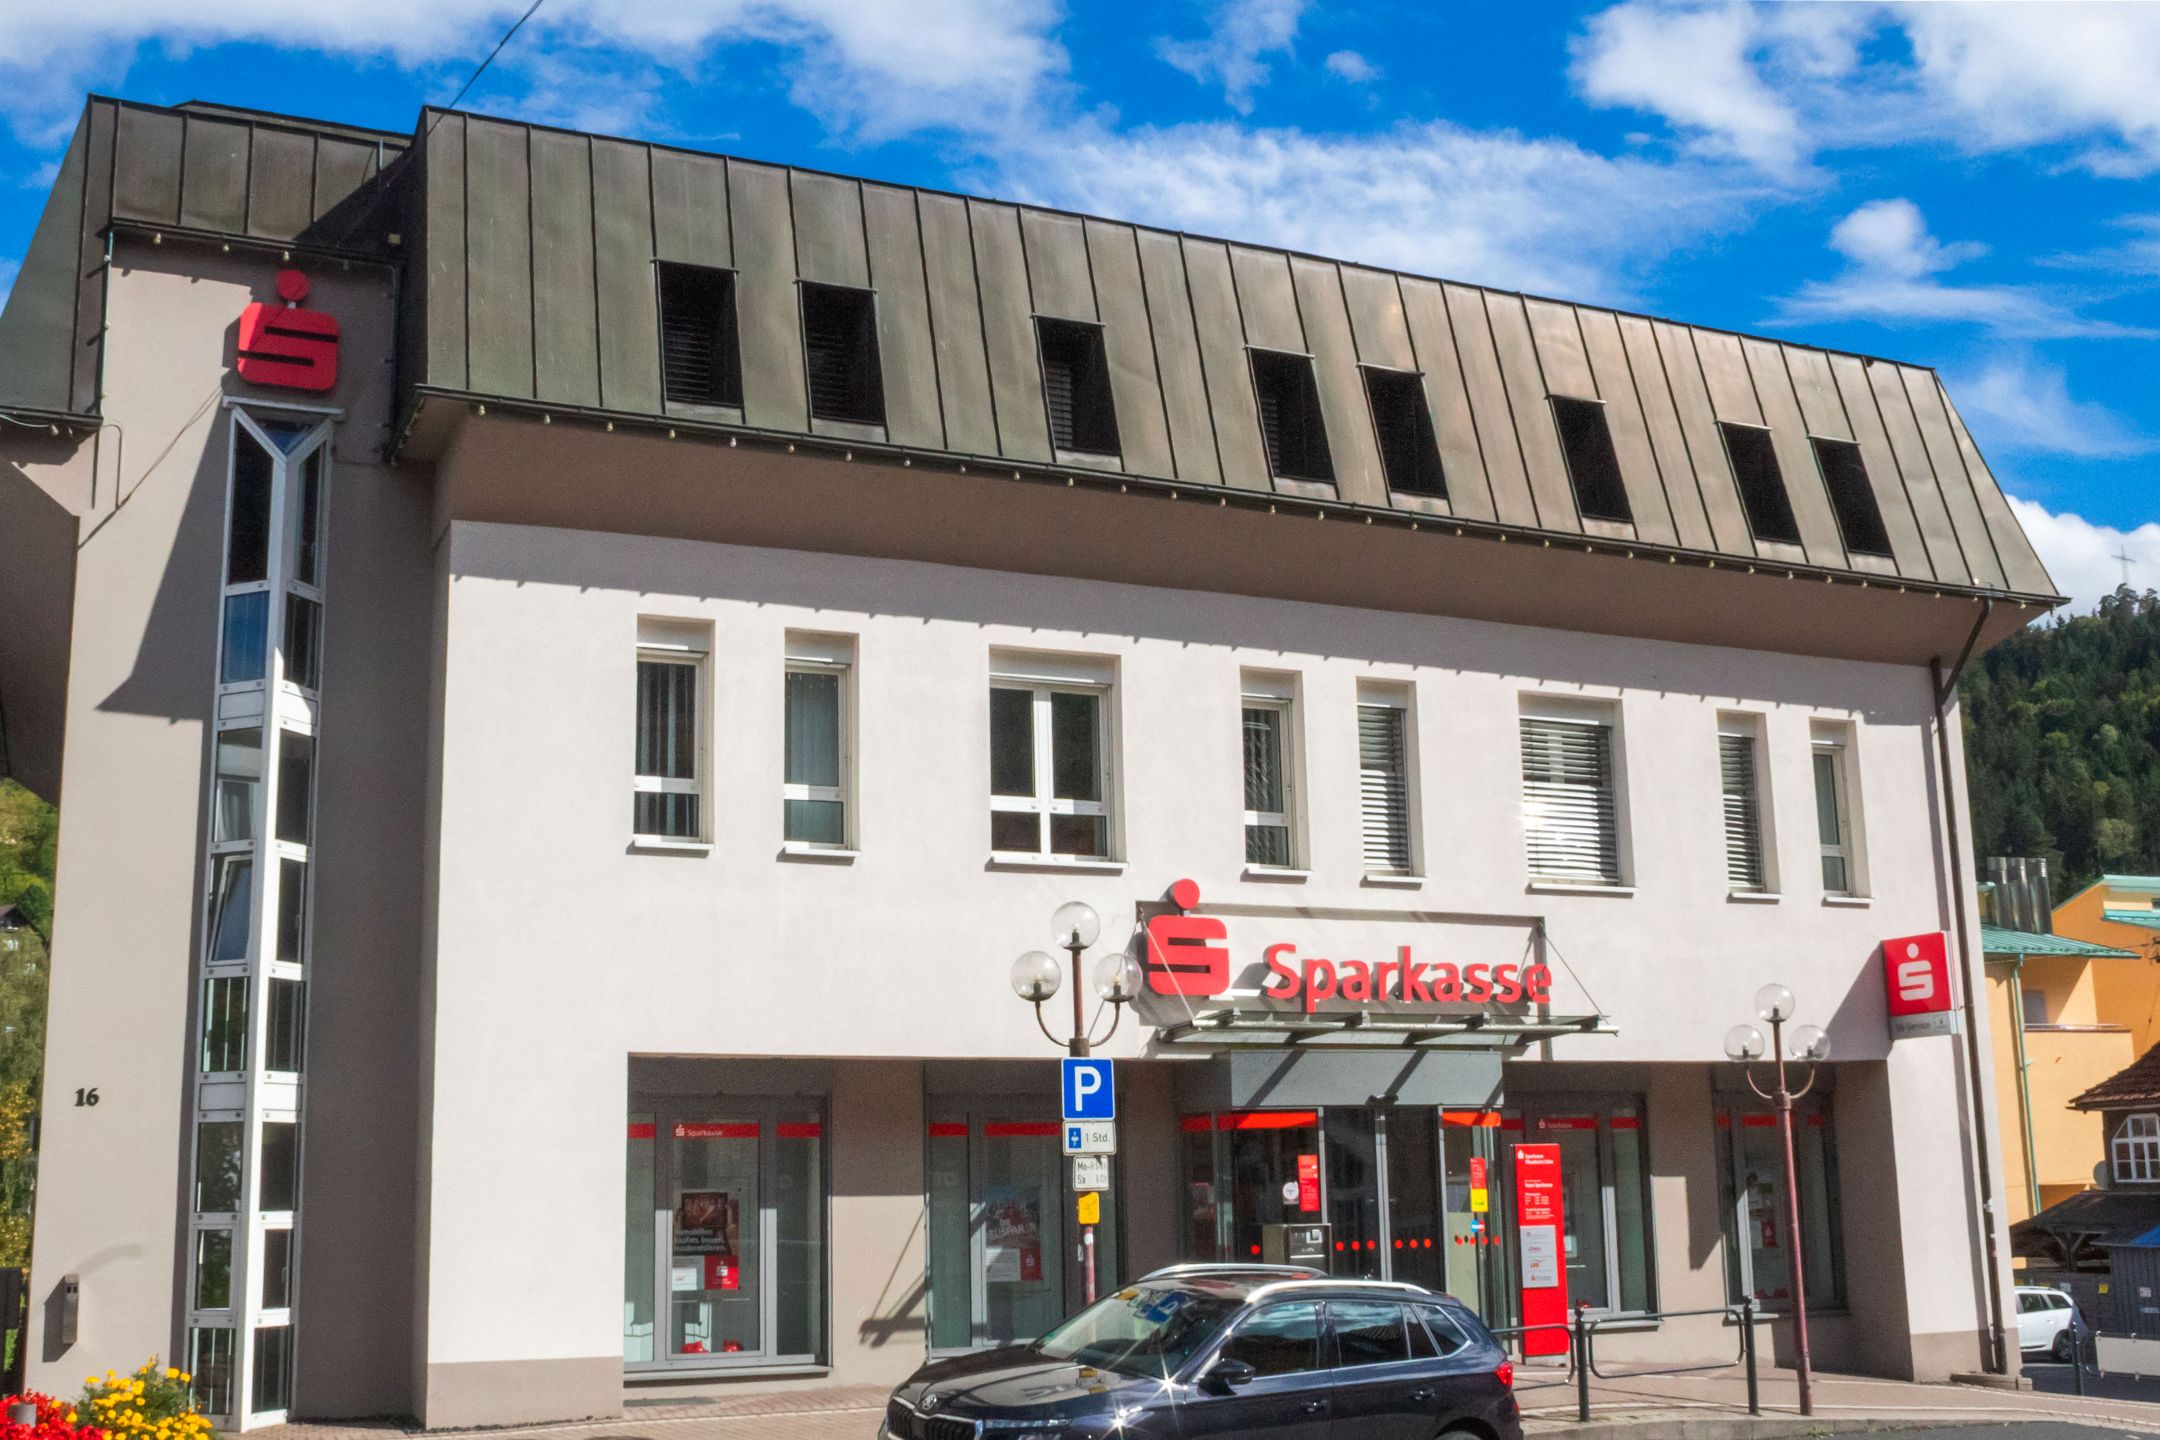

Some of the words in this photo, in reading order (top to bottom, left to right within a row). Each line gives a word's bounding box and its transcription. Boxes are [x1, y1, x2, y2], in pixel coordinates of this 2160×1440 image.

[1266, 943, 1553, 1014] Sparkasse
[74, 1087, 100, 1107] 16
[1074, 1066, 1102, 1112] P
[687, 1129, 723, 1138] Sparkasse
